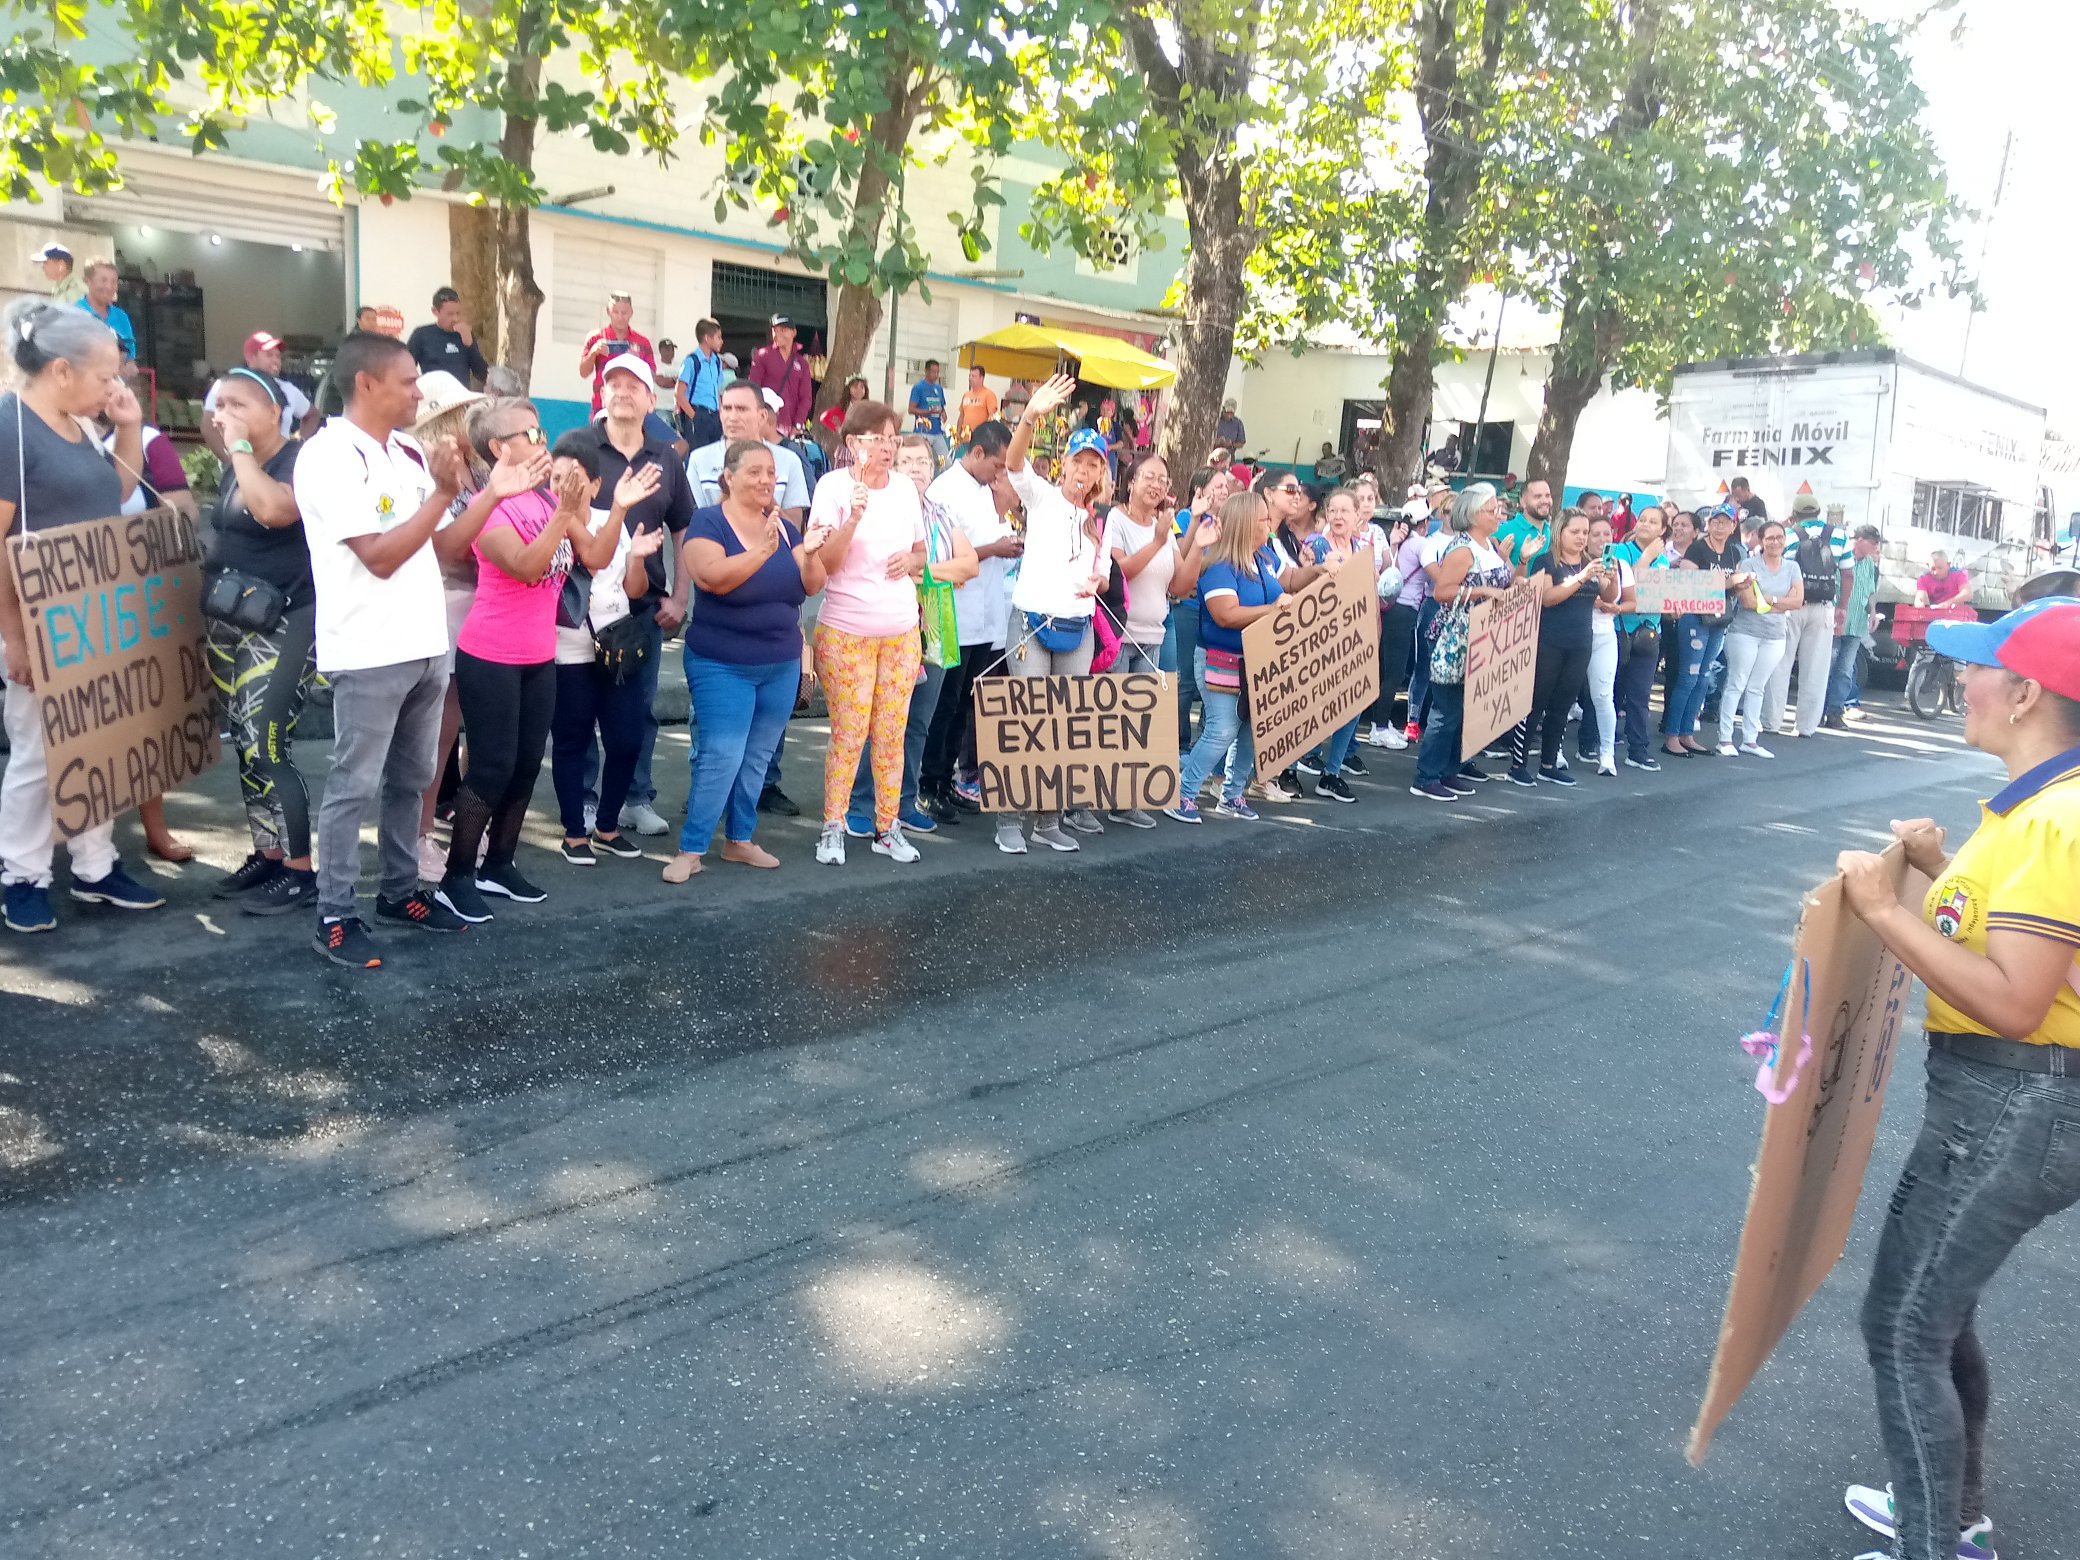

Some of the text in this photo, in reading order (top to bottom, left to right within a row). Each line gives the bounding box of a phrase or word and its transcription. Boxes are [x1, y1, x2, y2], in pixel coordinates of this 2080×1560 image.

[1790, 420, 1849, 443] Móvil
[13, 524, 121, 604] GREMIO
[1272, 581, 1342, 646] S.O.S.
[1467, 586, 1544, 680] EXIGEN
[1480, 616, 1486, 632] Y
[1663, 598, 1724, 612] DERECHOS
[1253, 596, 1368, 692] MAESTROS SIN
[1298, 628, 1364, 686] COMIDA
[42, 655, 165, 748] AUMENTO
[976, 674, 1158, 717] GREMIOS
[1256, 643, 1375, 739] SEGURO FUNERARIO
[1473, 646, 1532, 705] AUMENTO
[997, 713, 1152, 753] EXIGEN
[1259, 716, 1320, 772] POBREZA
[978, 760, 1176, 810] AUMENTO
